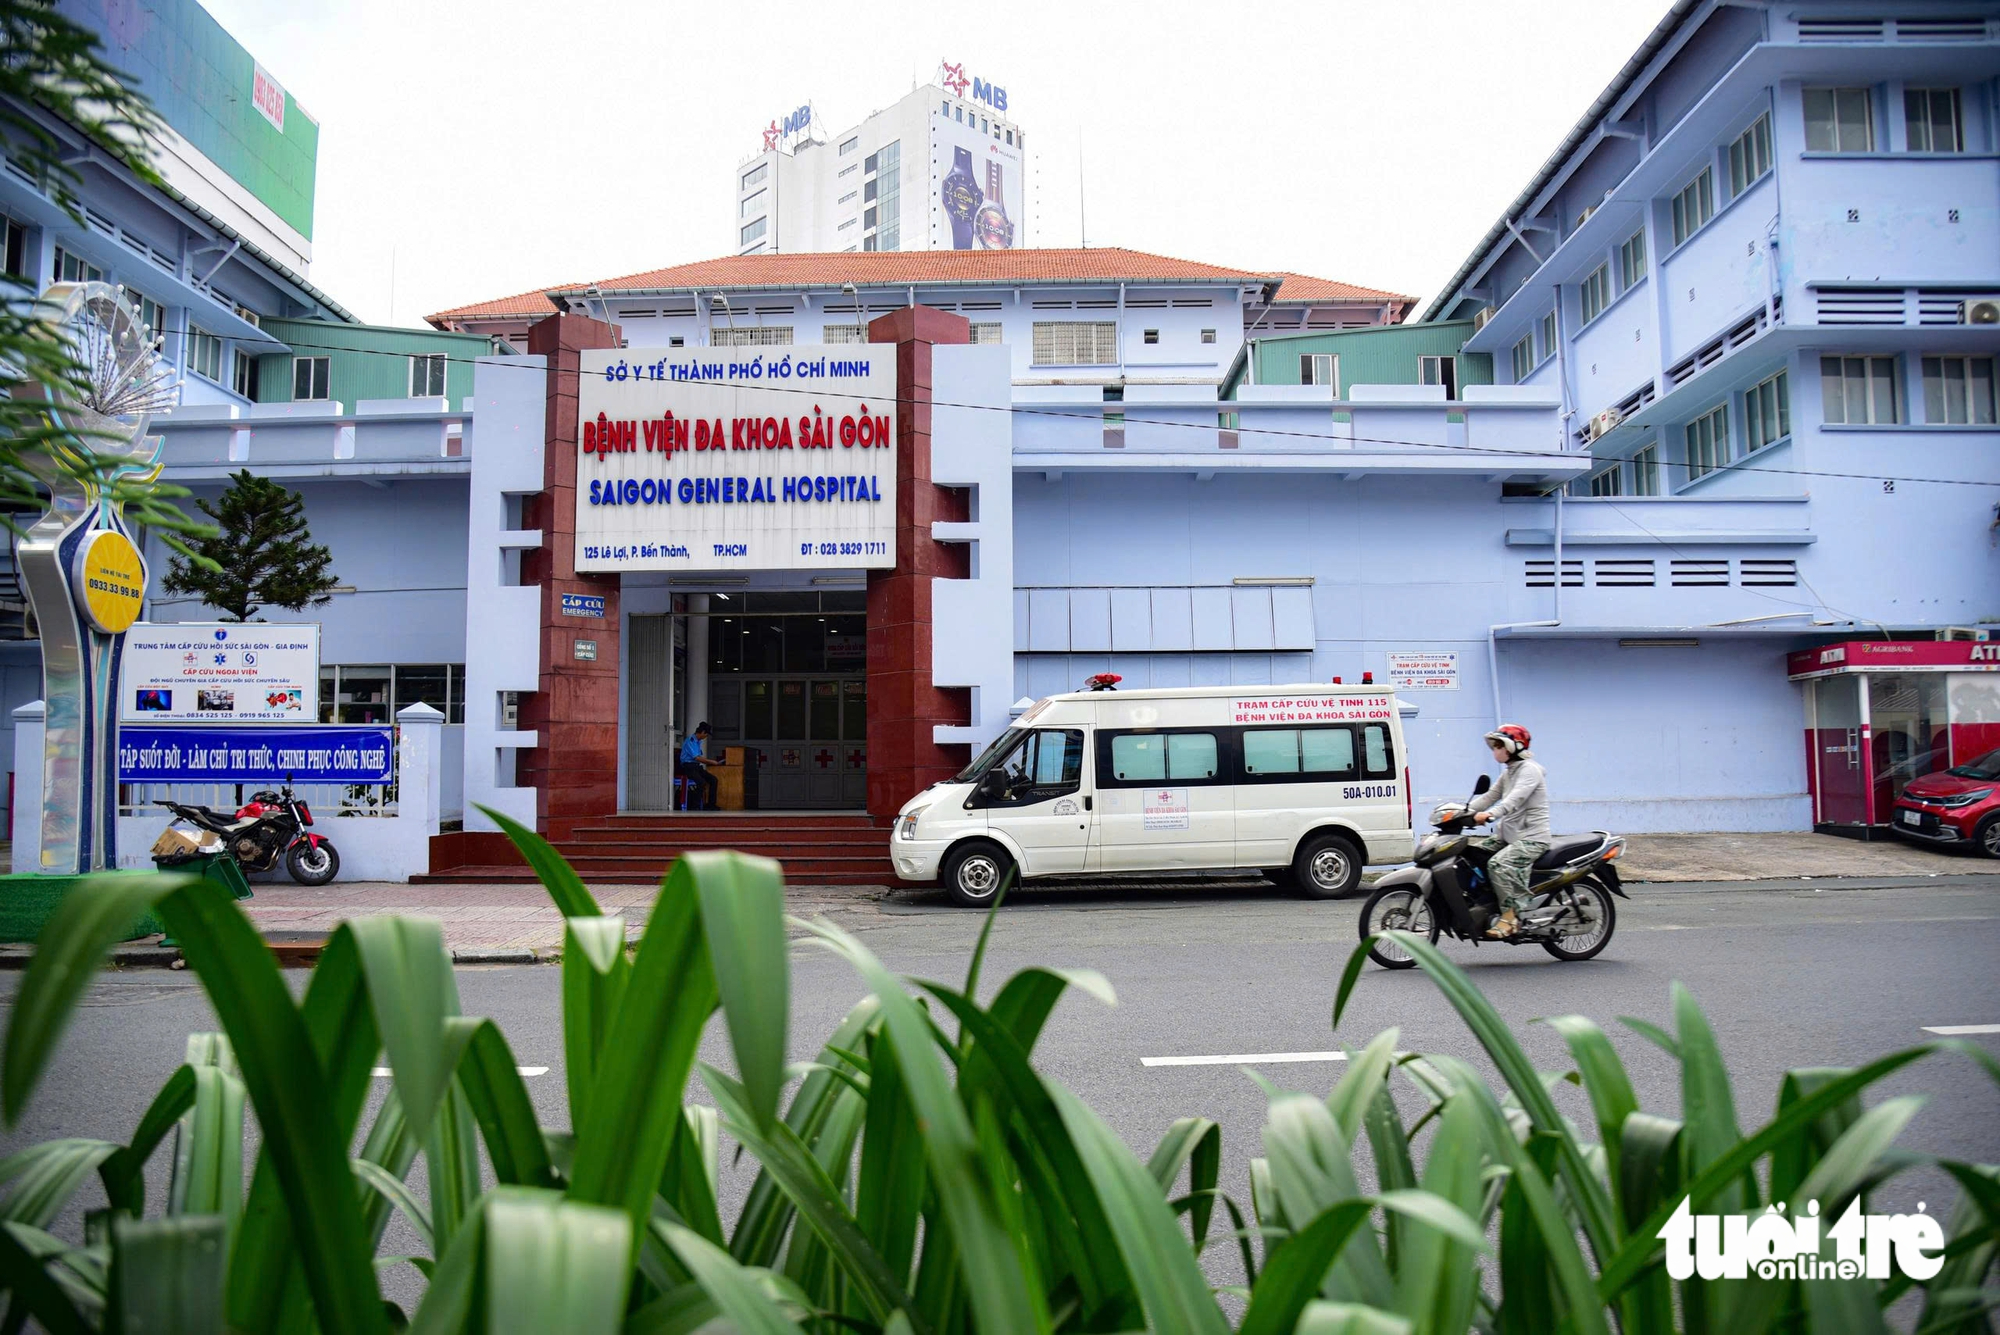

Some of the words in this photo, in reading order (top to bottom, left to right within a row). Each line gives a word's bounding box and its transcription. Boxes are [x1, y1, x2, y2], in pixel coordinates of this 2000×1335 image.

[972, 76, 1008, 112] MB
[784, 105, 810, 138] MB
[606, 360, 628, 382] SỞ
[634, 366, 642, 381] Y
[649, 358, 667, 380] TẾ
[670, 359, 724, 380] THÀNH
[728, 355, 763, 379] PHỐ
[768, 354, 792, 378] HỒ
[796, 360, 826, 378] CHÍ
[830, 361, 870, 378] MINH
[583, 412, 636, 461] BỆNH
[642, 410, 688, 460] VIỆN
[694, 418, 726, 451] ĐA
[732, 417, 793, 450] KHOA
[798, 404, 832, 449] SÀI
[840, 403, 890, 448] GÒN
[589, 478, 672, 506] SAIGON
[678, 476, 776, 504] GENERAL
[783, 476, 880, 502] HOSPITAL
[584, 547, 599, 559] 125
[601, 546, 611, 558] Lê
[614, 547, 628, 560] Lợi,
[631, 546, 639, 558] P.
[641, 542, 658, 558] Bến
[660, 546, 690, 560] Thành,
[714, 545, 747, 557] TP.HCM
[820, 543, 837, 555] 028
[840, 543, 862, 555] 3829
[864, 542, 886, 554] 1711
[562, 596, 582, 606] CẤP
[585, 599, 604, 608] CỨU
[563, 608, 604, 617] EMERGENCY
[1820, 648, 1845, 664] ATM
[1970, 645, 2000, 660] AT
[1237, 701, 1268, 710] TRẠM
[1272, 698, 1293, 708] CẤP
[1296, 698, 1318, 708] CỨU
[1322, 698, 1335, 708] VỆ
[1236, 712, 1265, 723] BỆNH
[1269, 711, 1295, 722] VIỆN
[1348, 709, 1365, 719] SÀI
[1369, 708, 1391, 718] GÒN
[120, 744, 138, 774] TẬP
[140, 740, 163, 769] SUỐT
[164, 744, 181, 769] ĐỜI
[188, 744, 208, 769] LÀM
[210, 741, 228, 769] CHỦ
[231, 750, 246, 769] TRI
[248, 744, 274, 772] THỨC,
[277, 750, 305, 769] CHINH
[308, 750, 331, 774] PHỤC
[334, 744, 358, 769] CÔNG
[360, 744, 385, 774] NGHỆ
[1343, 786, 1396, 799] 50A-010.01
